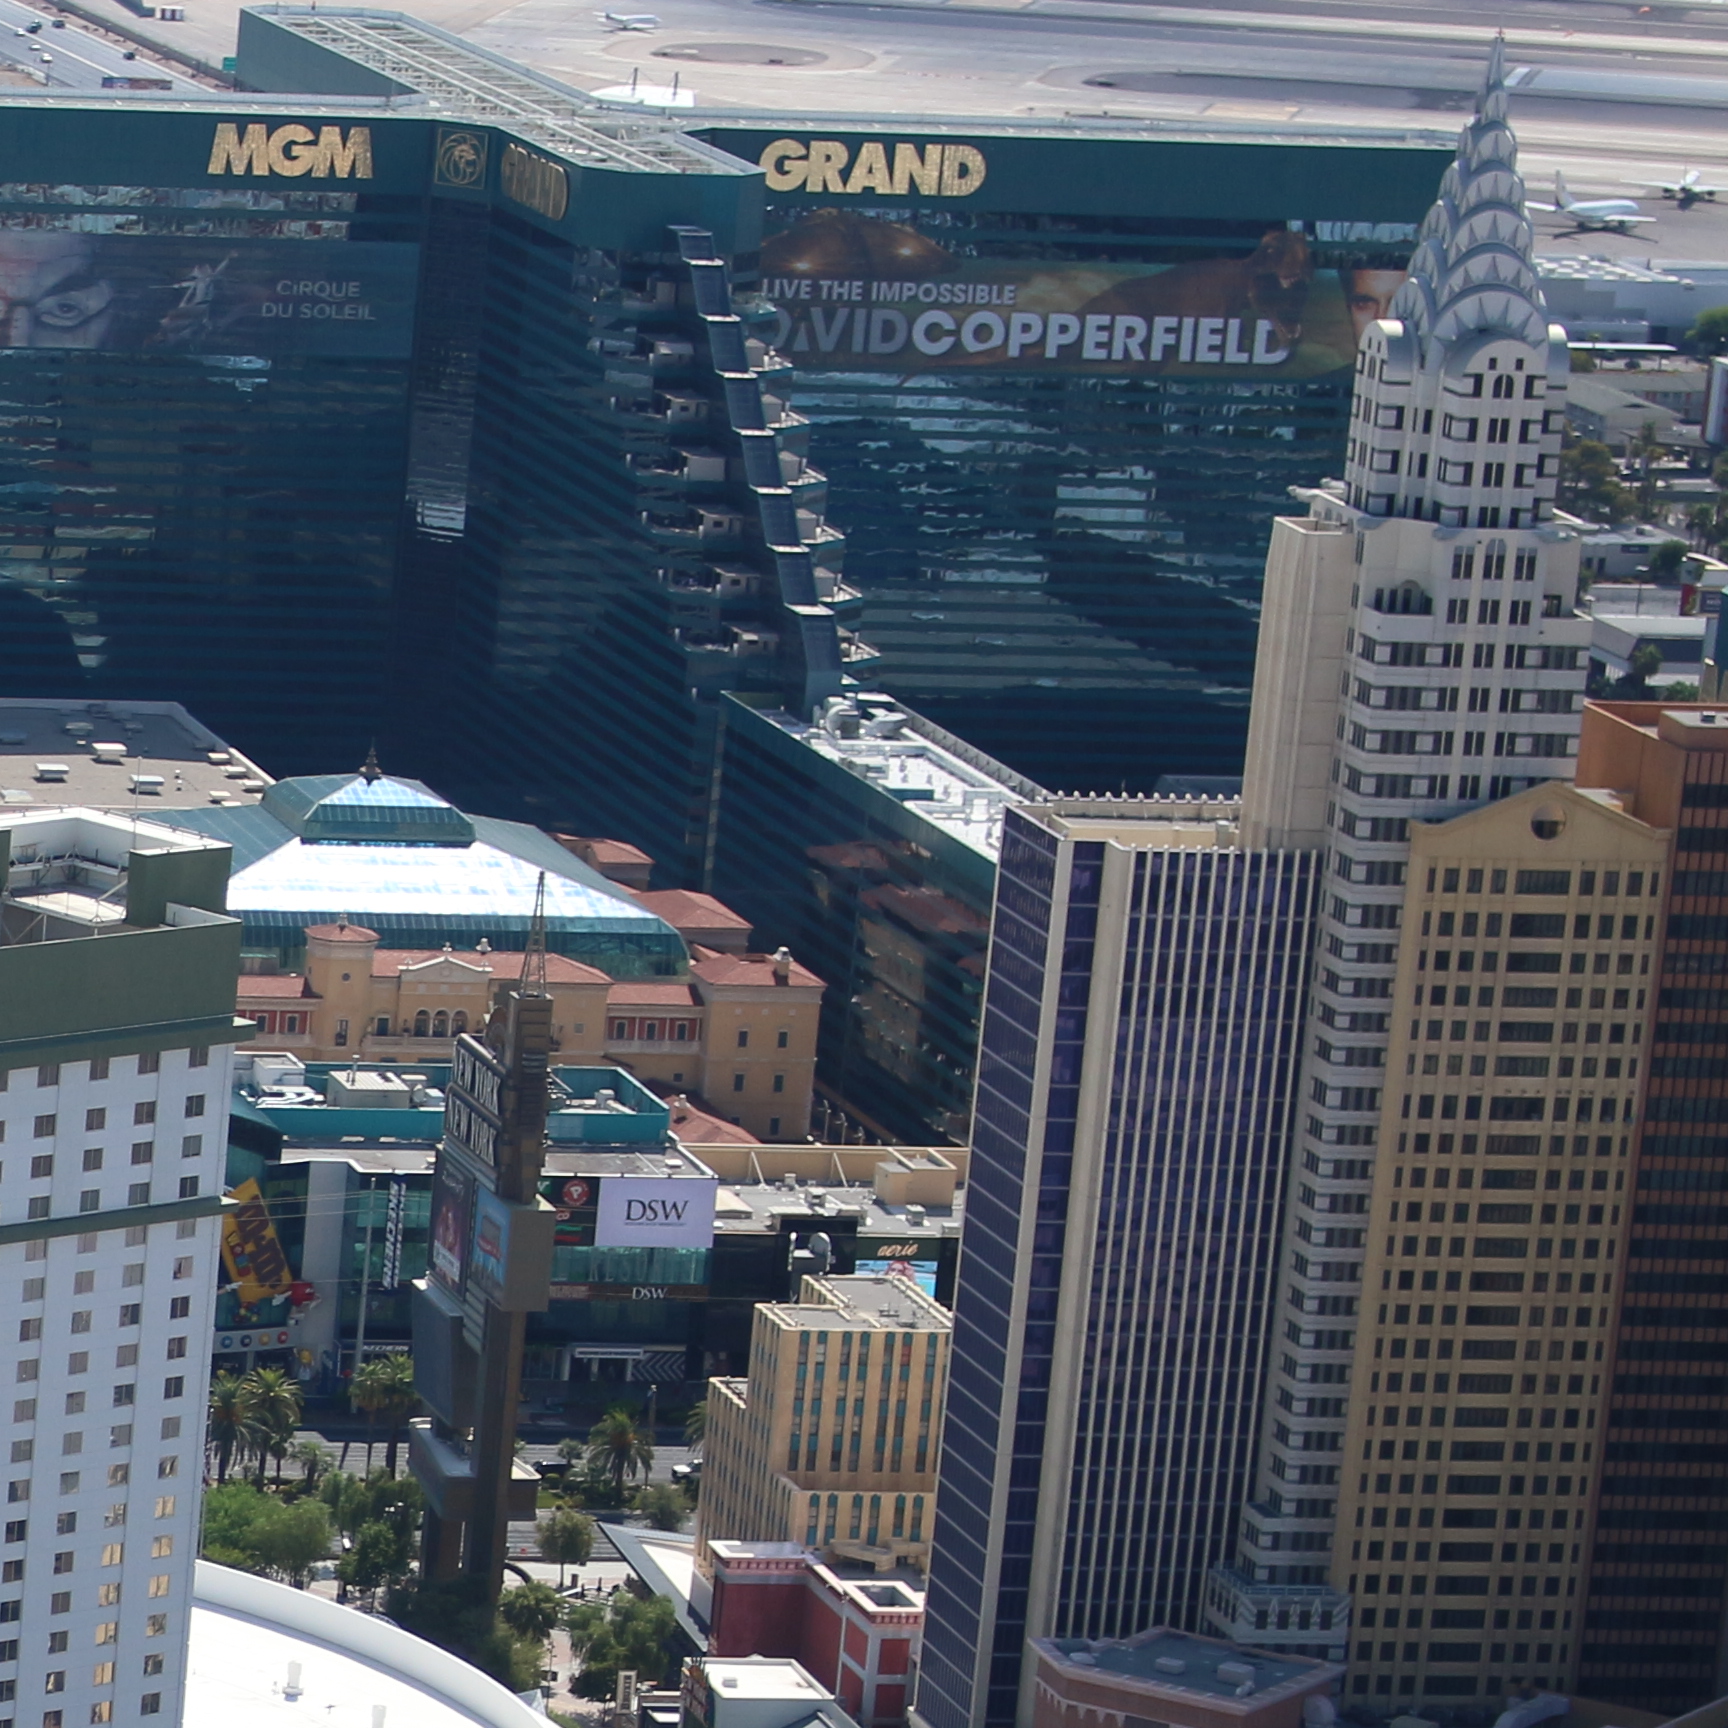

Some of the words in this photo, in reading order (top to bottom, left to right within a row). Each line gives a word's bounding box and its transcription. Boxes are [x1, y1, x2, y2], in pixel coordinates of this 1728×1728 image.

[207, 122, 373, 179] MGM
[758, 138, 986, 197] GRAND
[819, 280, 864, 302] THE
[872, 281, 1017, 306] IMPOSSIBLE
[261, 302, 293, 319] DU
[474, 1060, 501, 1116] YORK
[446, 1093, 470, 1142] NEW
[470, 1111, 497, 1167] YORK
[624, 1199, 689, 1222] DSW
[876, 1239, 919, 1259] aerie
[631, 1286, 668, 1300] DSW
